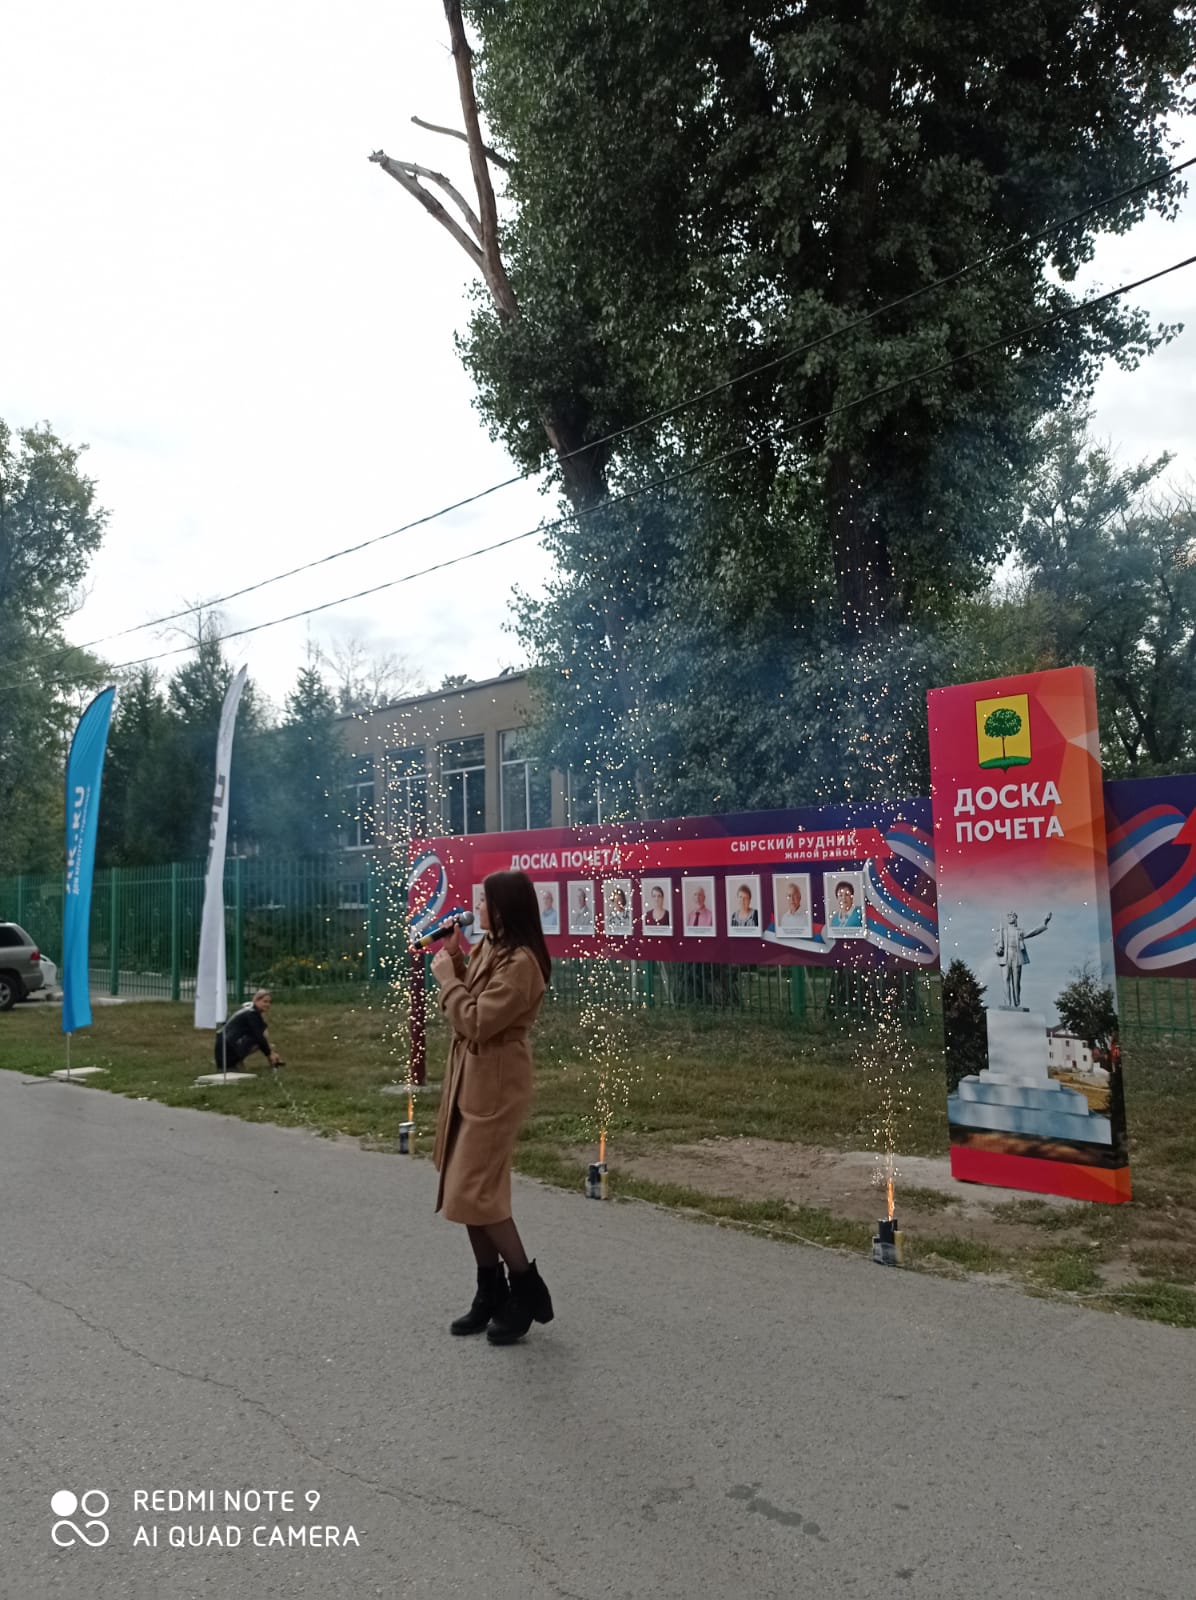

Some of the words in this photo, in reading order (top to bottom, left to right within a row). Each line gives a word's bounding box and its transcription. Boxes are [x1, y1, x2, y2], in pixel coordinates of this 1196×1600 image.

[953, 780, 1062, 816] ДОСКА
[955, 815, 1064, 843] ПОЧЕТА
[730, 836, 794, 852] СЫРСКИЙ
[798, 834, 857, 849] РУДНИК
[784, 849, 819, 859] жилой
[822, 848, 857, 859] район
[509, 852, 558, 872] ДОСКА
[561, 848, 621, 868] ПОЧЕТА
